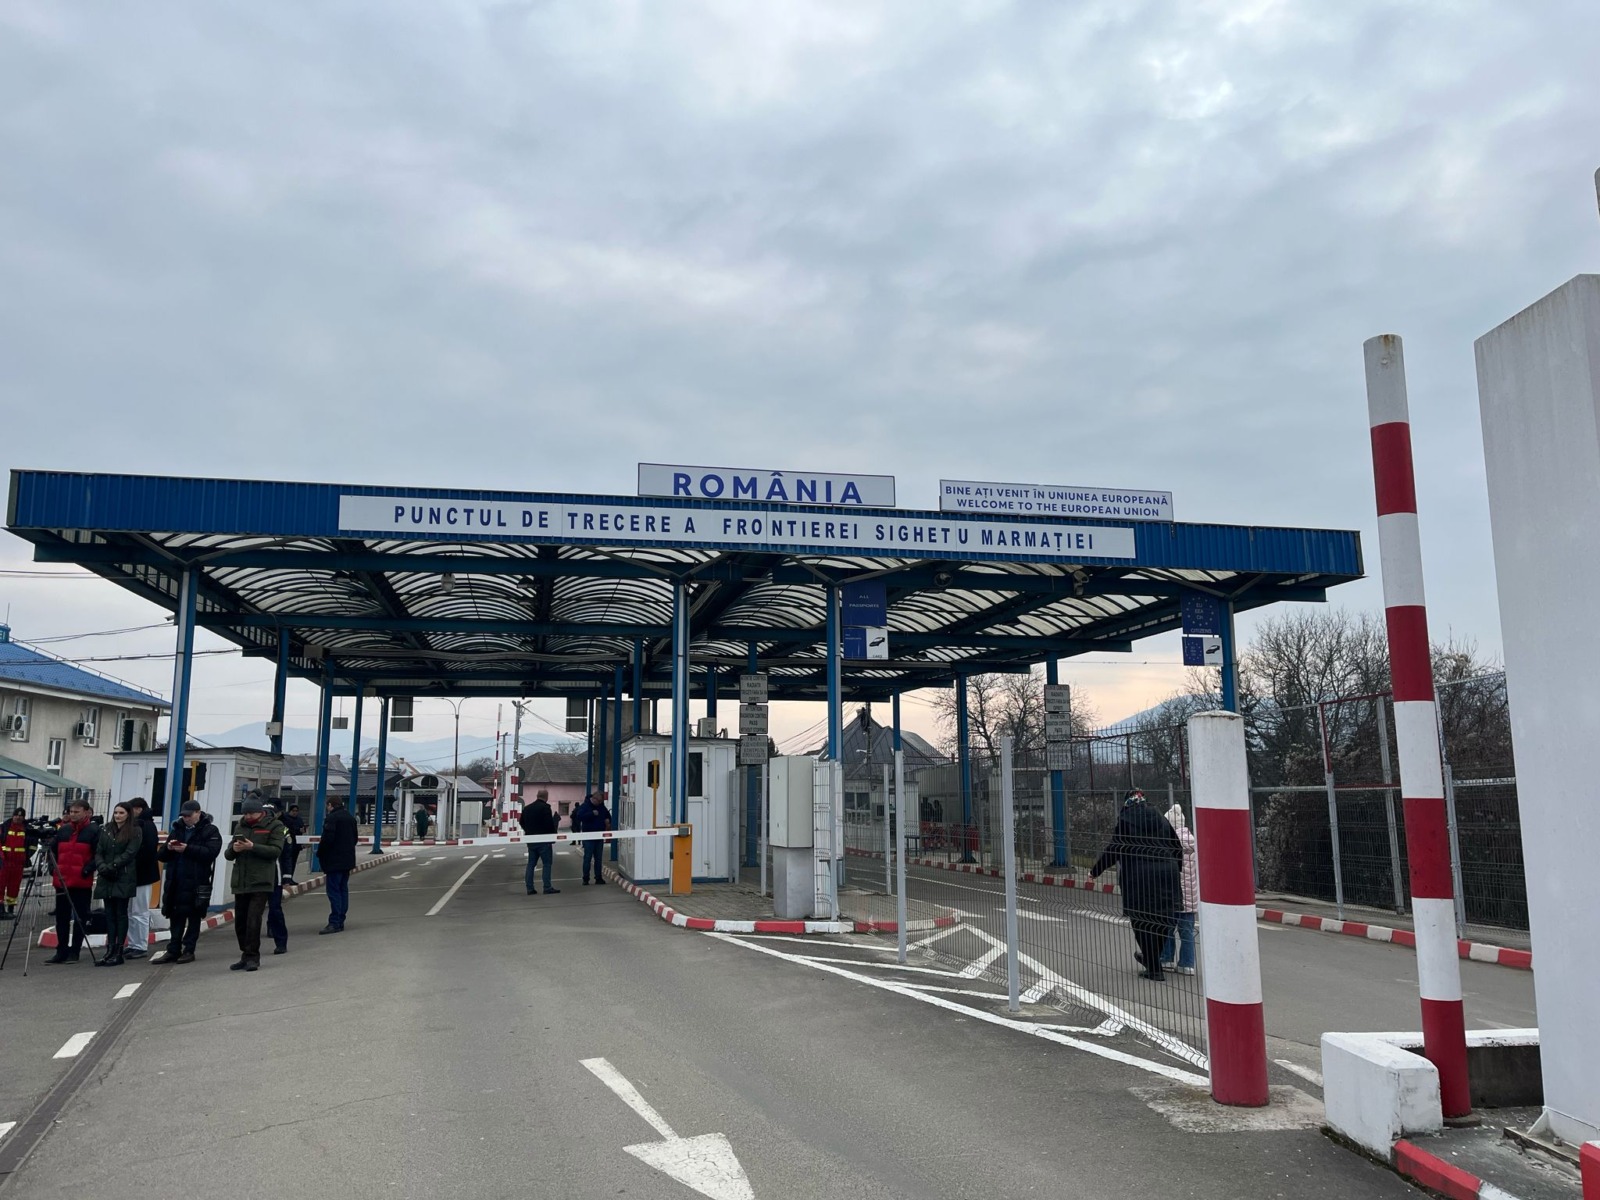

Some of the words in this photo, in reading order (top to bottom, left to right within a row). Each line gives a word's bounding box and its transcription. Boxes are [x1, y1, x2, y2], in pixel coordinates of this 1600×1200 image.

[673, 471, 863, 503] ROMÂNIA
[945, 486, 971, 496] BINE
[975, 488, 993, 500] AȚI
[997, 489, 1030, 499] VENIT
[1033, 489, 1045, 500] ÎN
[1048, 491, 1099, 502] UNIUNEA
[1102, 494, 1169, 506] EUROPEANĂ
[957, 499, 1014, 510] WELCOME
[1017, 501, 1033, 511] TO
[1036, 502, 1058, 512] THE
[1061, 503, 1120, 515] EUROPEAN
[1123, 507, 1160, 517] UNION
[394, 505, 507, 528] PUNCTUL
[522, 510, 549, 528] DE
[568, 512, 671, 533] TRECERE
[684, 516, 697, 534] A
[723, 518, 859, 540] FRONTIEREI
[876, 524, 968, 545] SIGHETU
[982, 529, 1093, 552] MARMAȚIEI
